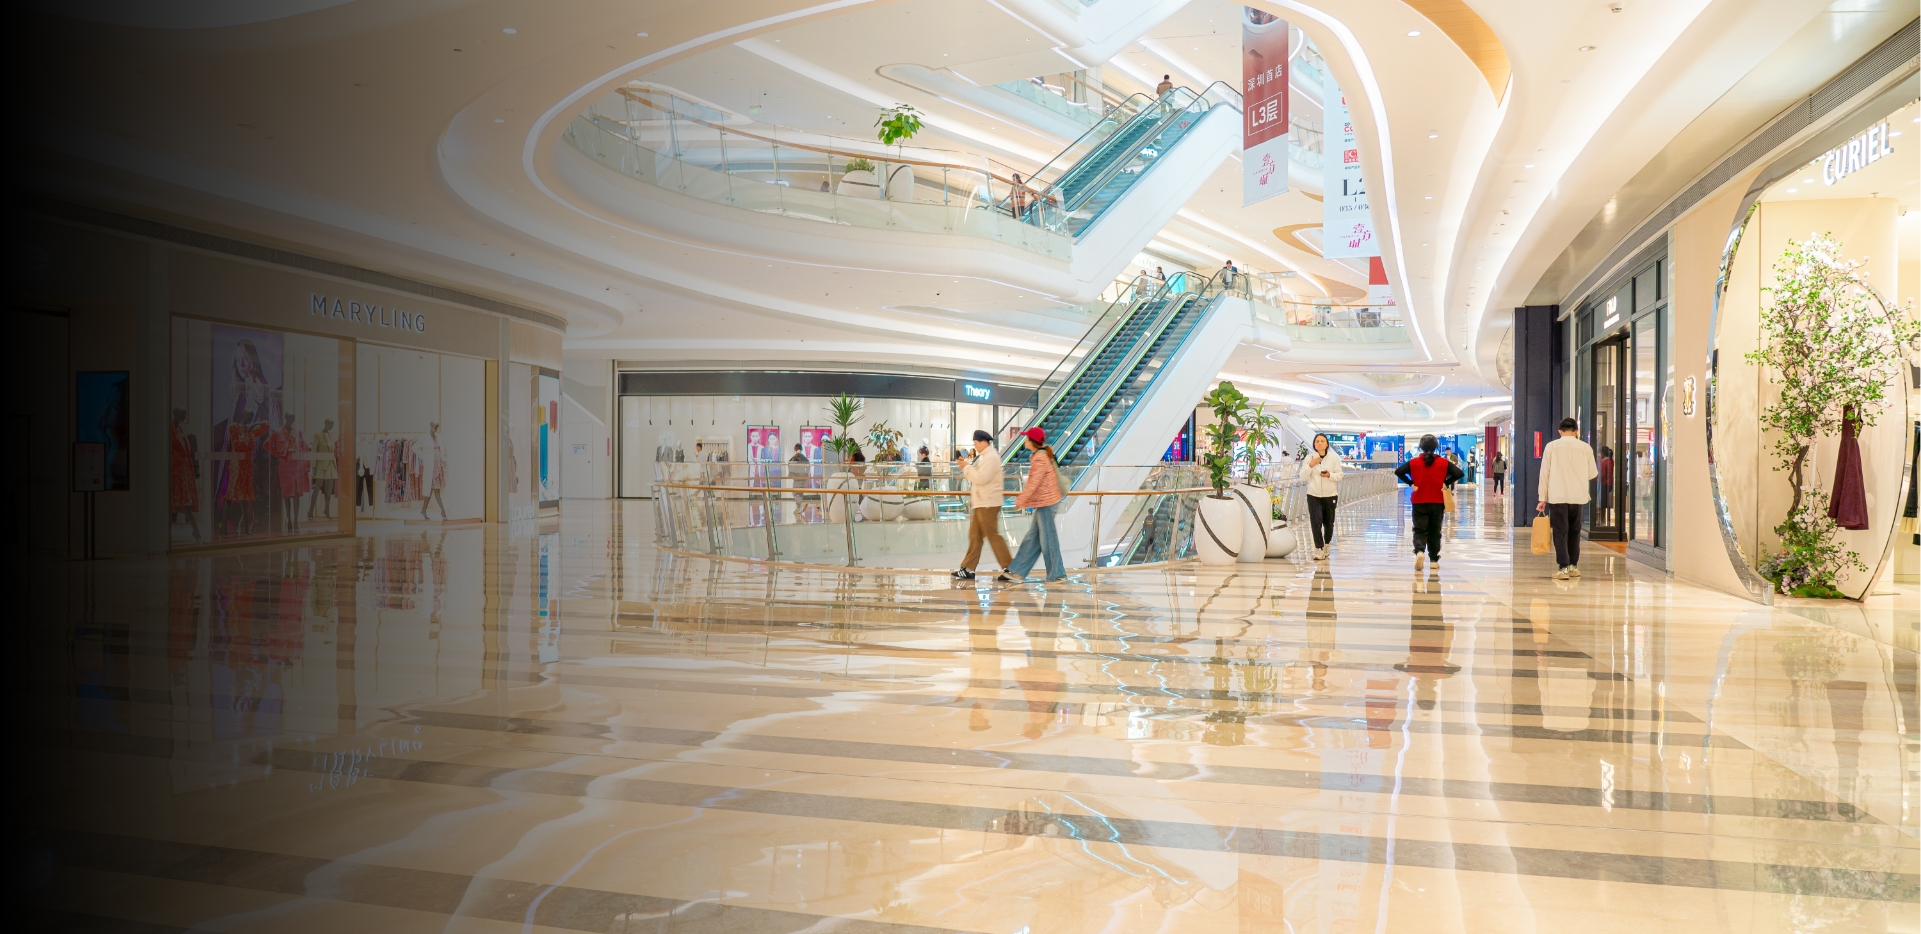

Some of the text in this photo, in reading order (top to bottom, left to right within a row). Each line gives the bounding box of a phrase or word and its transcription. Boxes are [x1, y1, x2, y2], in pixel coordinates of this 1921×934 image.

[1247, 64, 1283, 92] 深圳首店
[1252, 99, 1278, 128] L3层
[1823, 122, 1892, 186] CURIEL
[309, 293, 426, 333] MARYLING
[965, 385, 991, 400] Theory
